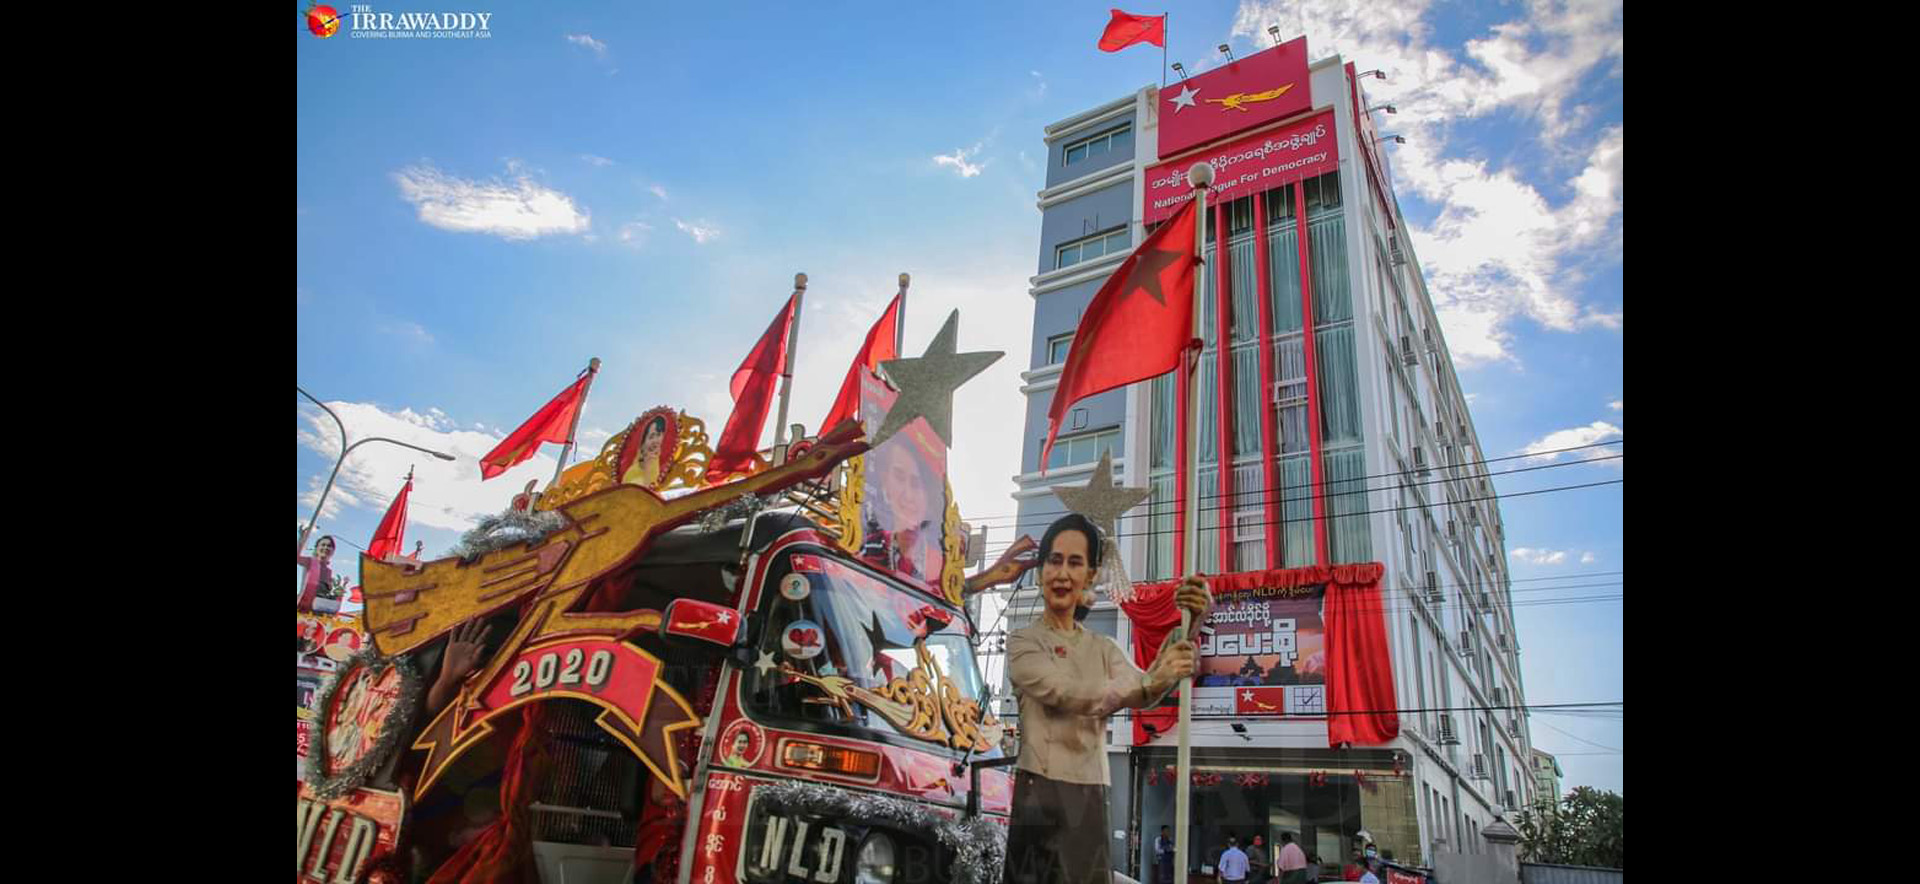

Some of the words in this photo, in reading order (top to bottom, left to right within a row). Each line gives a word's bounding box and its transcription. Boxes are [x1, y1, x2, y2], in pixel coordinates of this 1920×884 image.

[1154, 188, 1197, 209] National
[1240, 172, 1259, 184] For
[1262, 151, 1328, 177] Democracy
[510, 648, 615, 698] 2020
[760, 814, 846, 884] NLD
